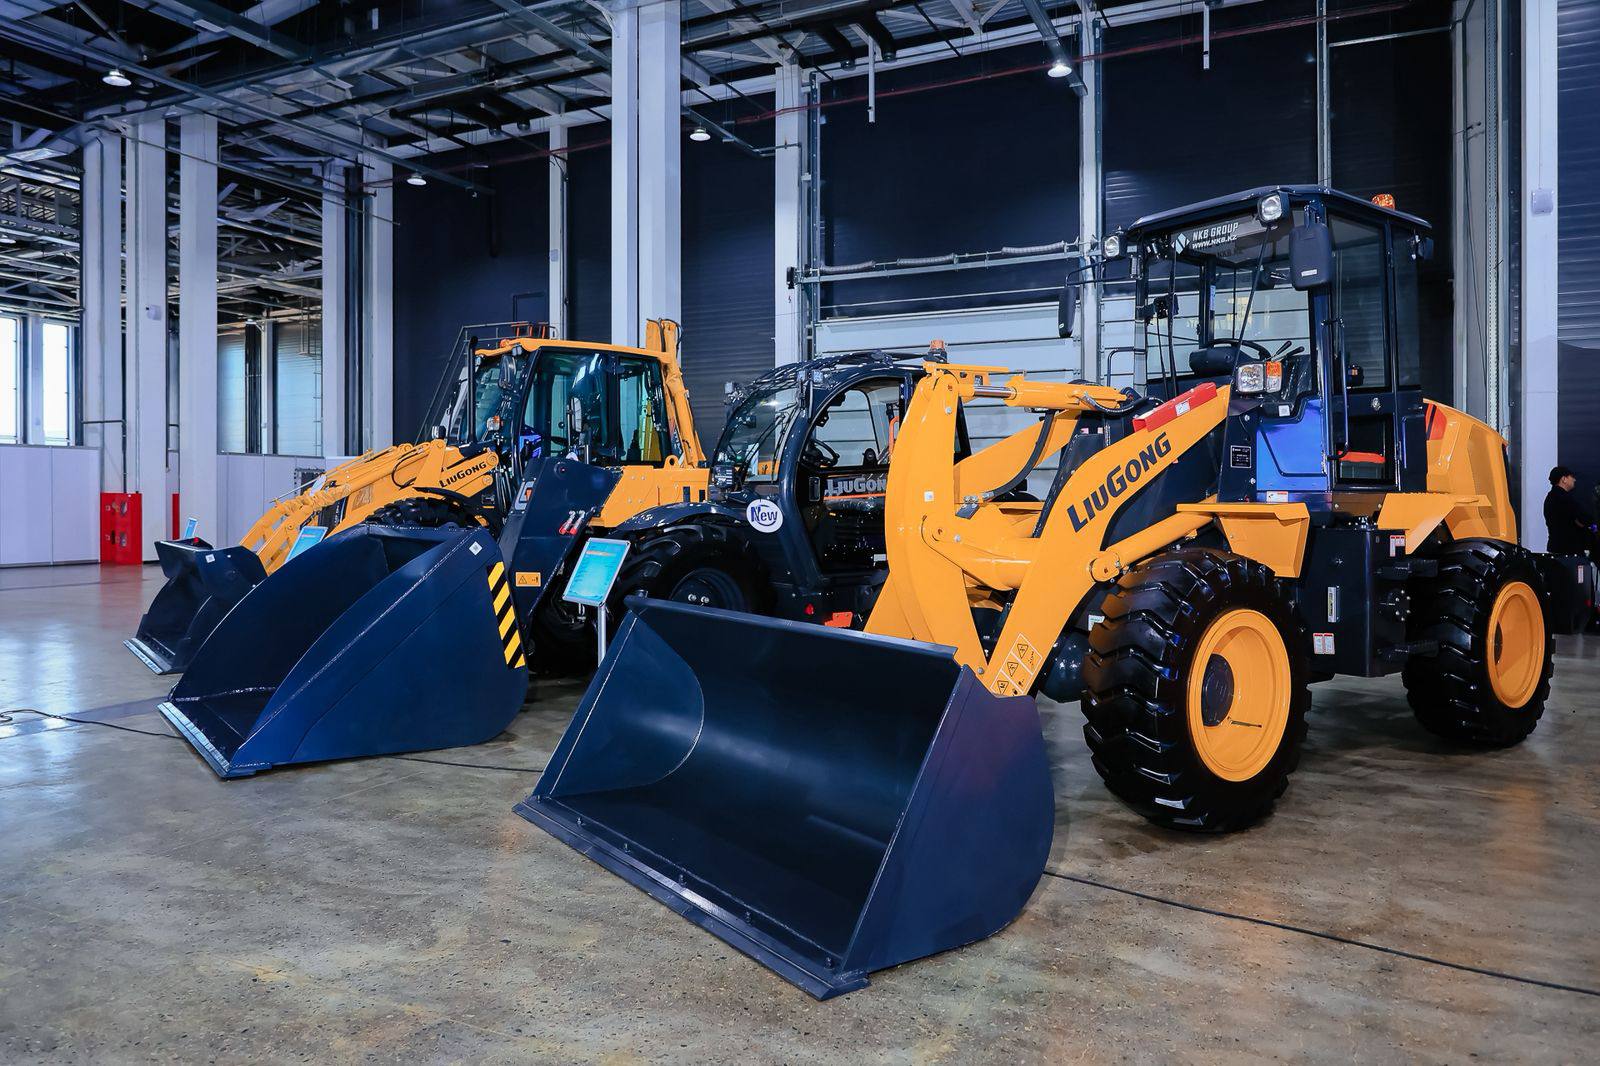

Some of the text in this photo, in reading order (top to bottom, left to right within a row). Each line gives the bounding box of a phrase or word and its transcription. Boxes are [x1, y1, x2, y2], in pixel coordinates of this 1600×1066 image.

[1193, 222, 1239, 241] NKB GROUP
[826, 477, 886, 495] LIUGON
[751, 506, 778, 522] New
